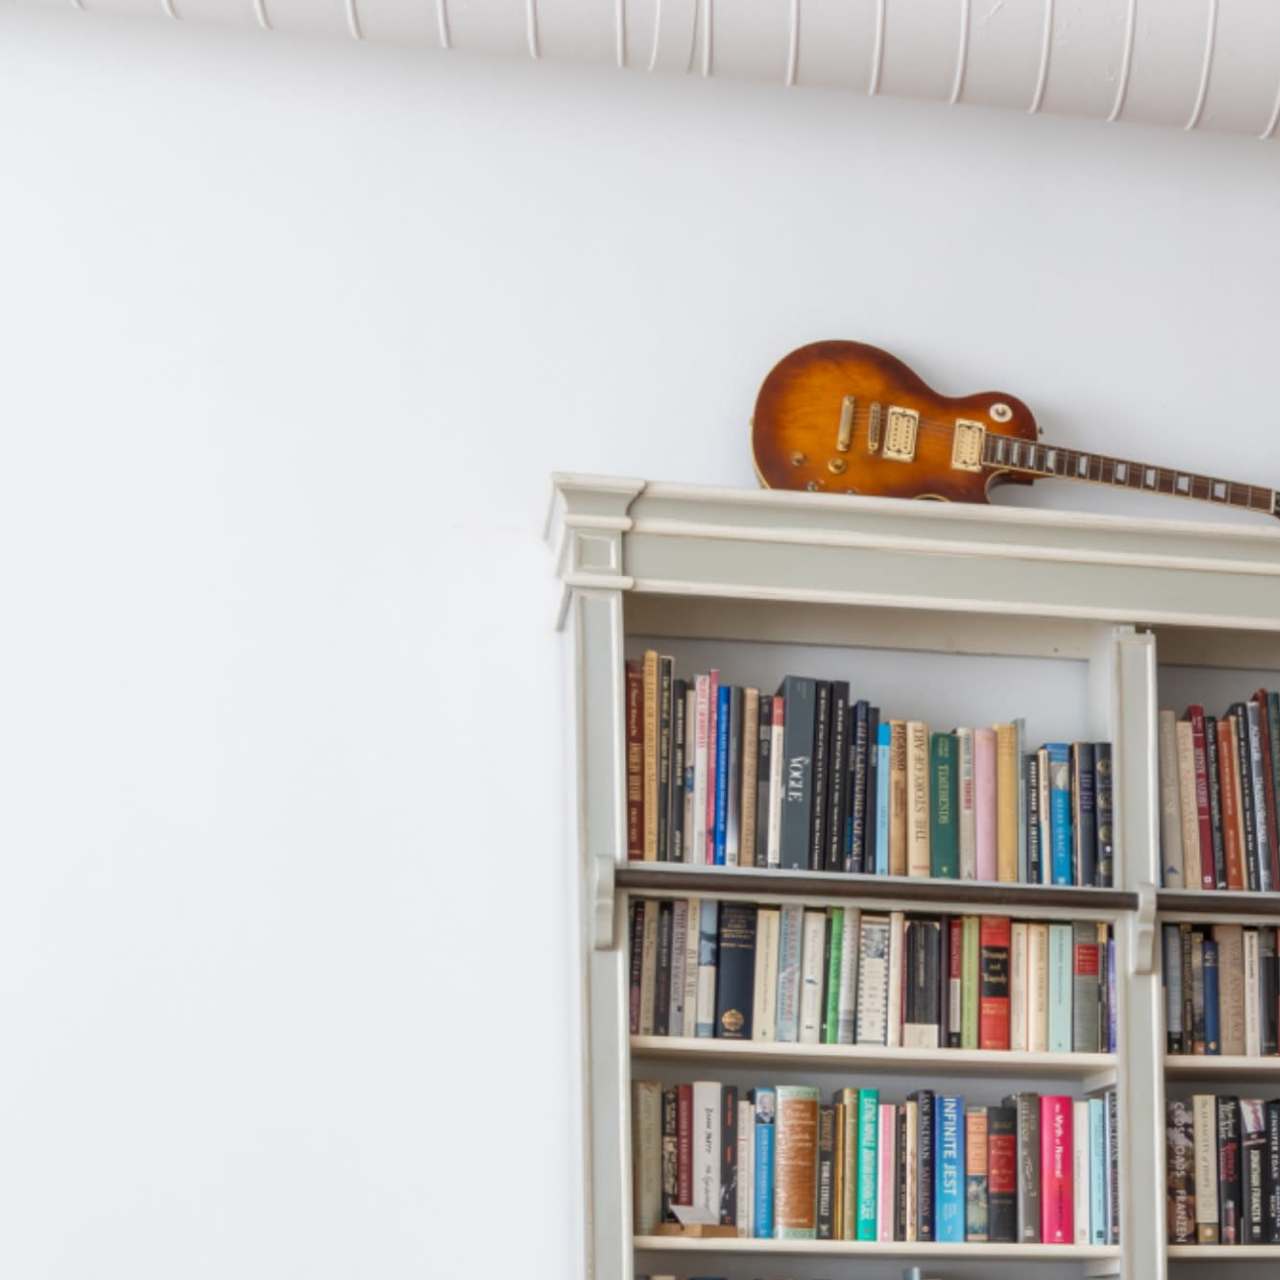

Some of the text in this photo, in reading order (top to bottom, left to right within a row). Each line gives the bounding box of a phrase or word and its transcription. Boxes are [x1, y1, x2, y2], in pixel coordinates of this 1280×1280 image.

[913, 728, 926, 749] ART
[788, 756, 811, 803] VOGUE
[854, 754, 866, 818] CENTURIES
[914, 775, 926, 813] STORY
[942, 1097, 958, 1159] INFINITE
[1053, 1114, 1064, 1137] Myth
[1271, 1109, 1280, 1151] JENNIFER
[942, 1162, 958, 1196] JEST
[1054, 1145, 1064, 1178] Normal
[1175, 1189, 1188, 1243] FRANZEN
[1250, 1187, 1262, 1223] FRANZEN
